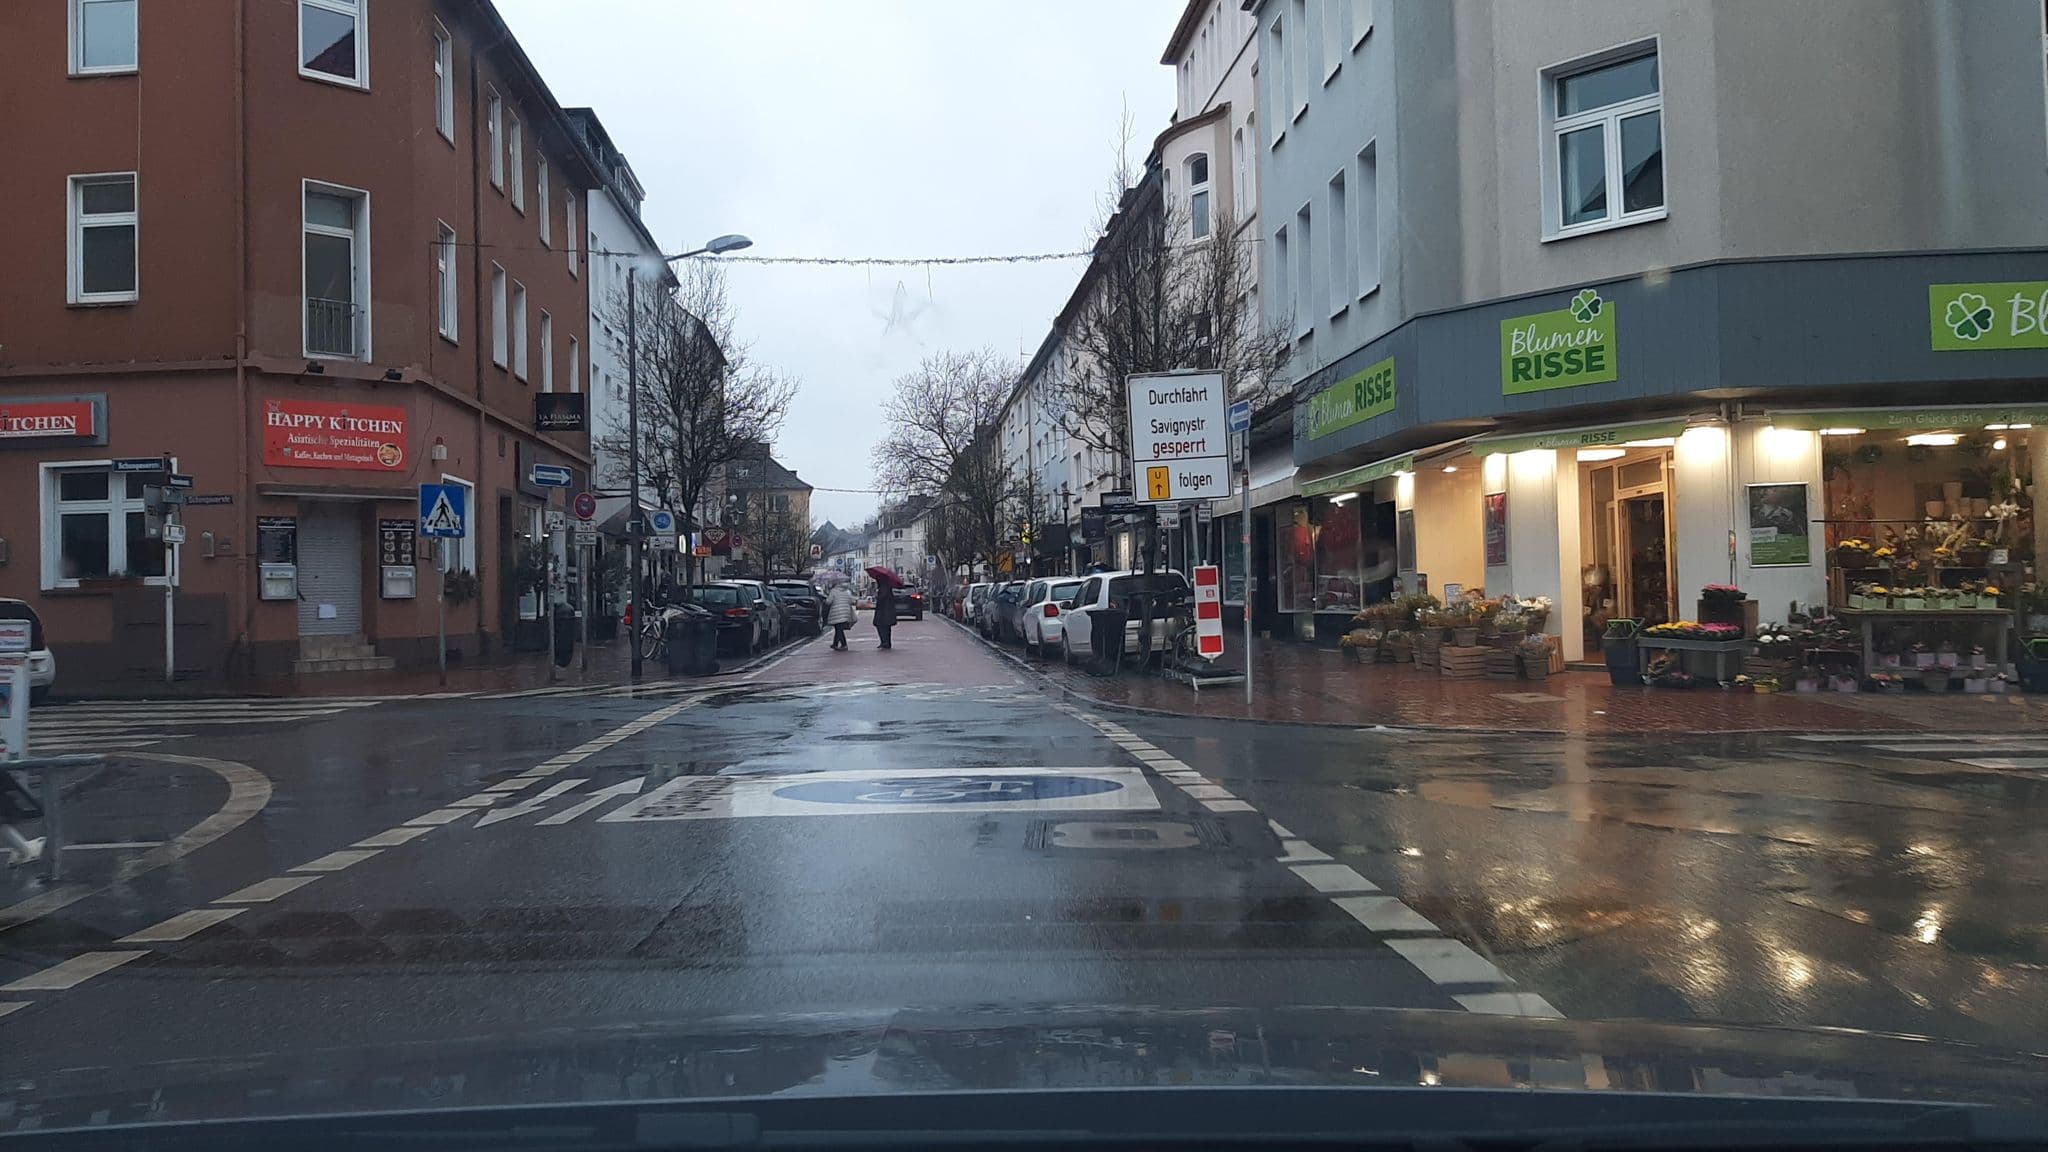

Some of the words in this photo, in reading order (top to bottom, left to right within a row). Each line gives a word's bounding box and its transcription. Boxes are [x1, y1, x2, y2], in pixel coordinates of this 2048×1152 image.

[1510, 323, 1604, 356] Blumen
[1512, 345, 1606, 383] RISSE
[1148, 387, 1208, 406] Durchfahrt
[1354, 367, 1393, 412] RISSE
[267, 411, 326, 430] HAPPY
[329, 411, 402, 434] KITCHEN
[1888, 414, 1913, 425] Zum
[1915, 413, 1950, 424] Glück
[329, 434, 381, 450] Spezialitäten
[1580, 431, 1617, 444] RISSE
[1152, 438, 1206, 459] gesperrt
[1154, 471, 1162, 480] U
[1179, 472, 1213, 491] folgen
